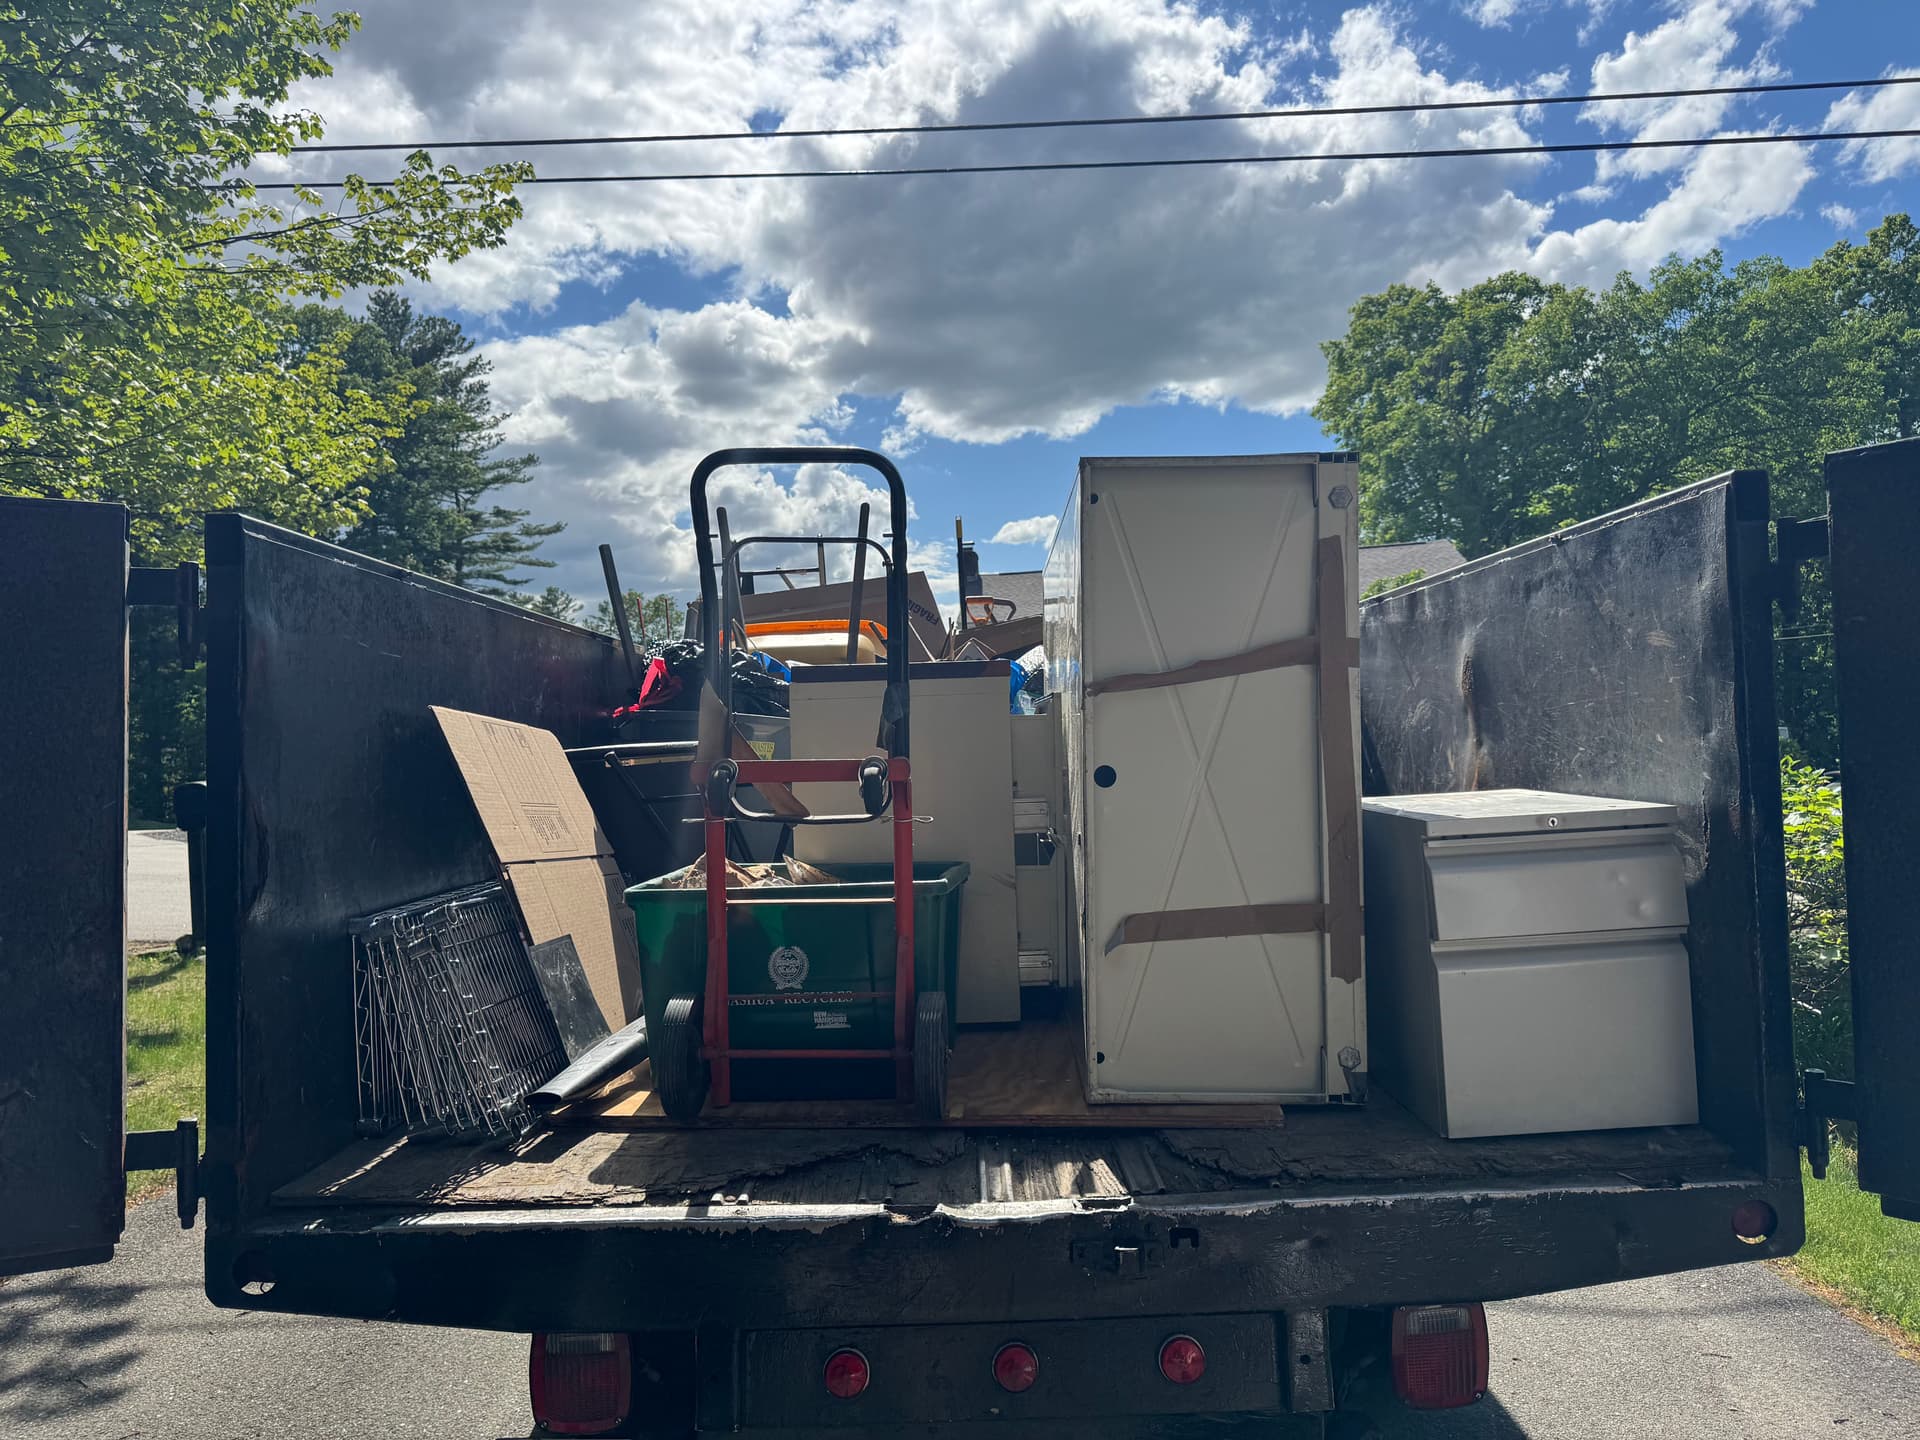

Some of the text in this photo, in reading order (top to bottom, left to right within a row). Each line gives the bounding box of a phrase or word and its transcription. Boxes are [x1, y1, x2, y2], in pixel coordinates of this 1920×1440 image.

[908, 599, 939, 625] FRAGI
[728, 990, 854, 1006] ASHUA RECYCLES
